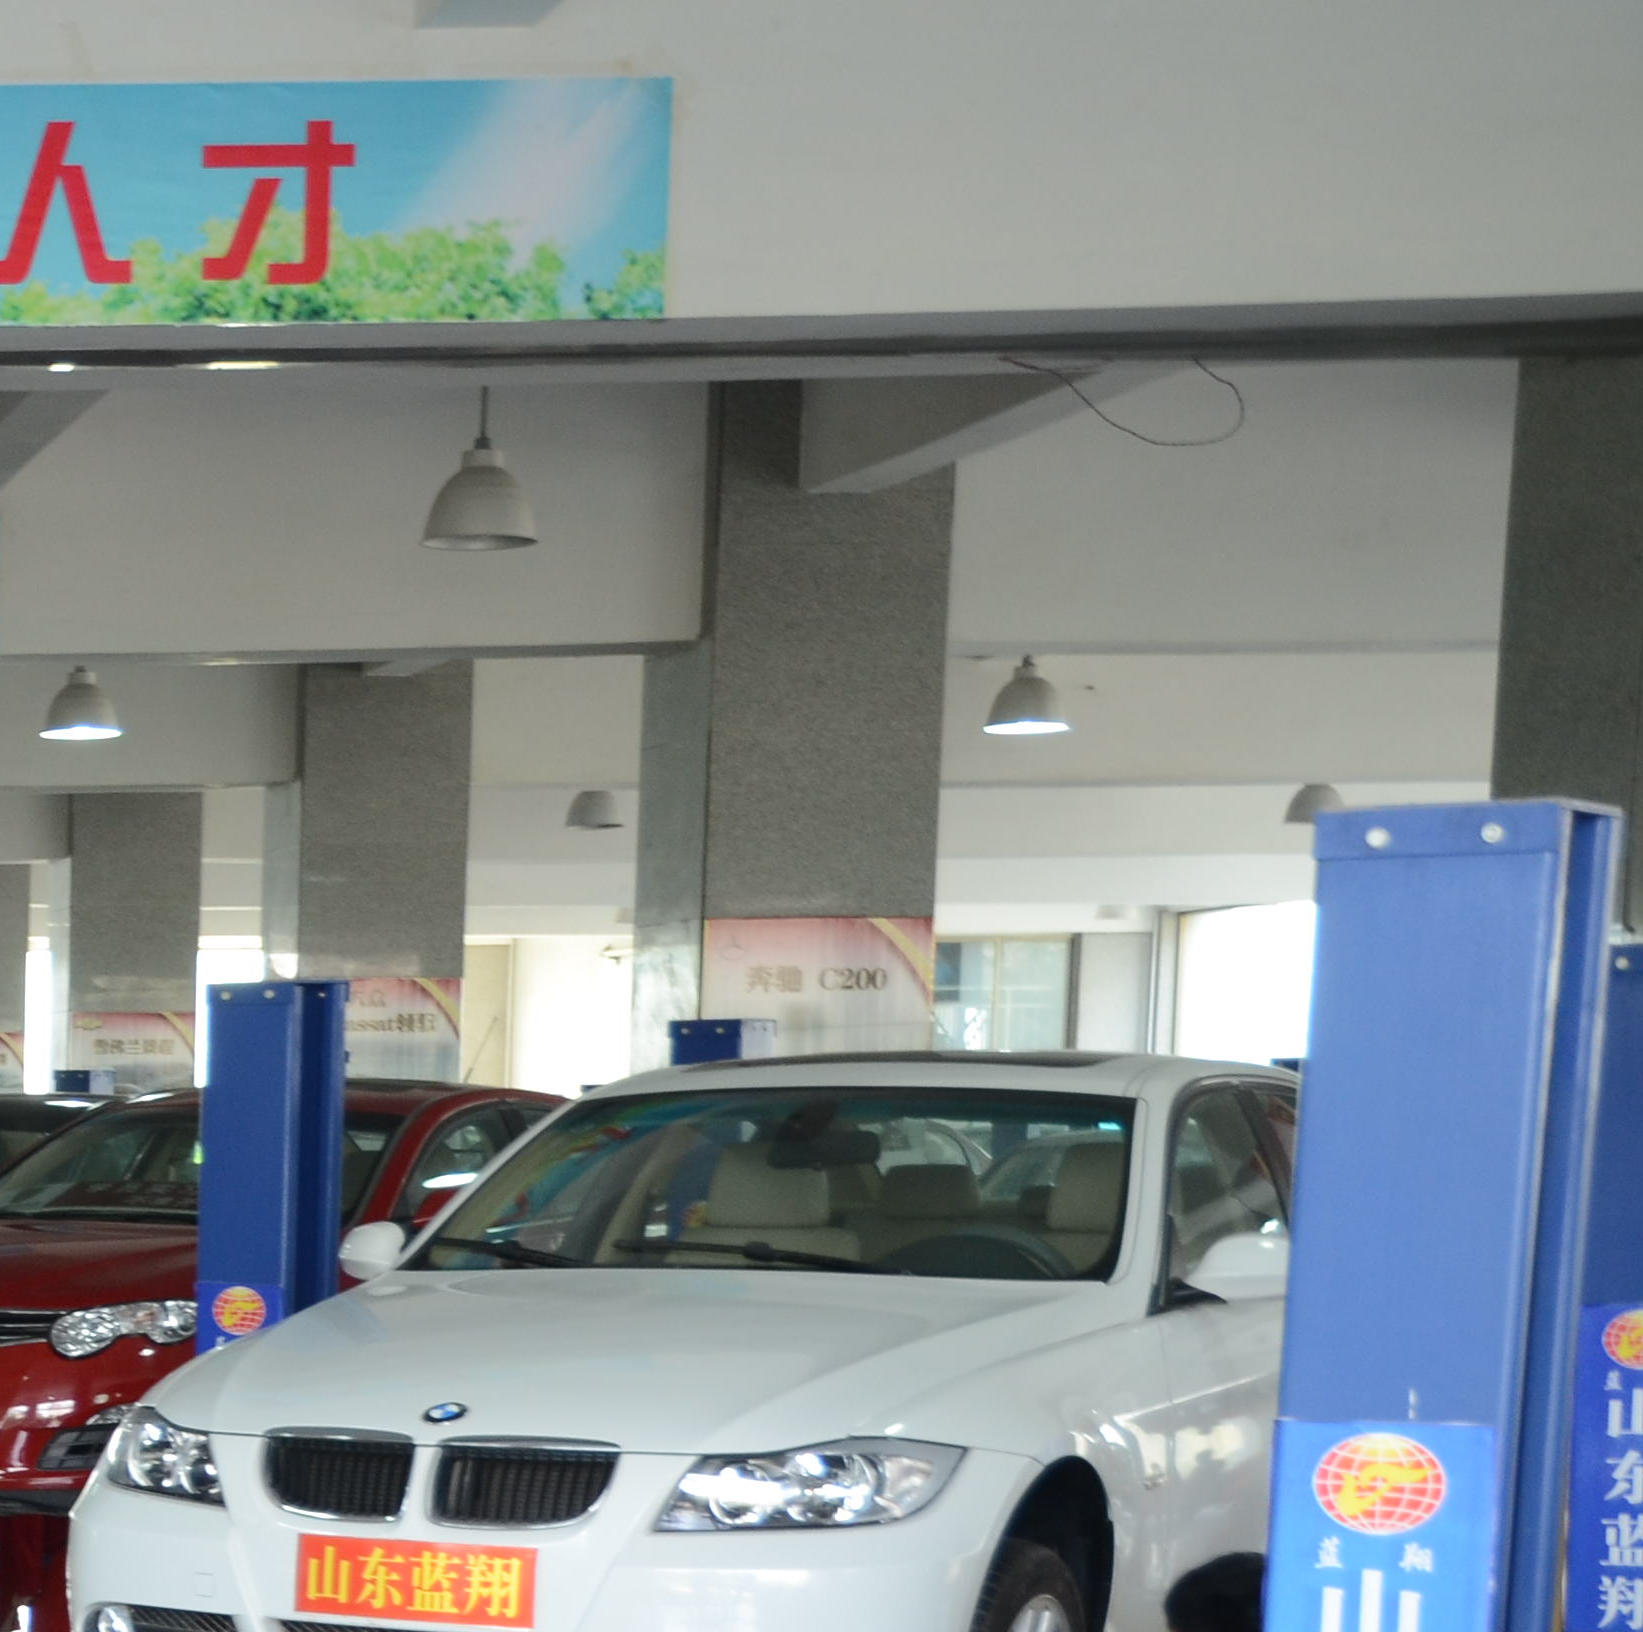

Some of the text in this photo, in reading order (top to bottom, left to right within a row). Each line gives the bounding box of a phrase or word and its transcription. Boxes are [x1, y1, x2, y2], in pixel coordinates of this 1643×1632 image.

[818, 967, 888, 991] C200
[306, 1545, 523, 1619] 山东蓝翔
